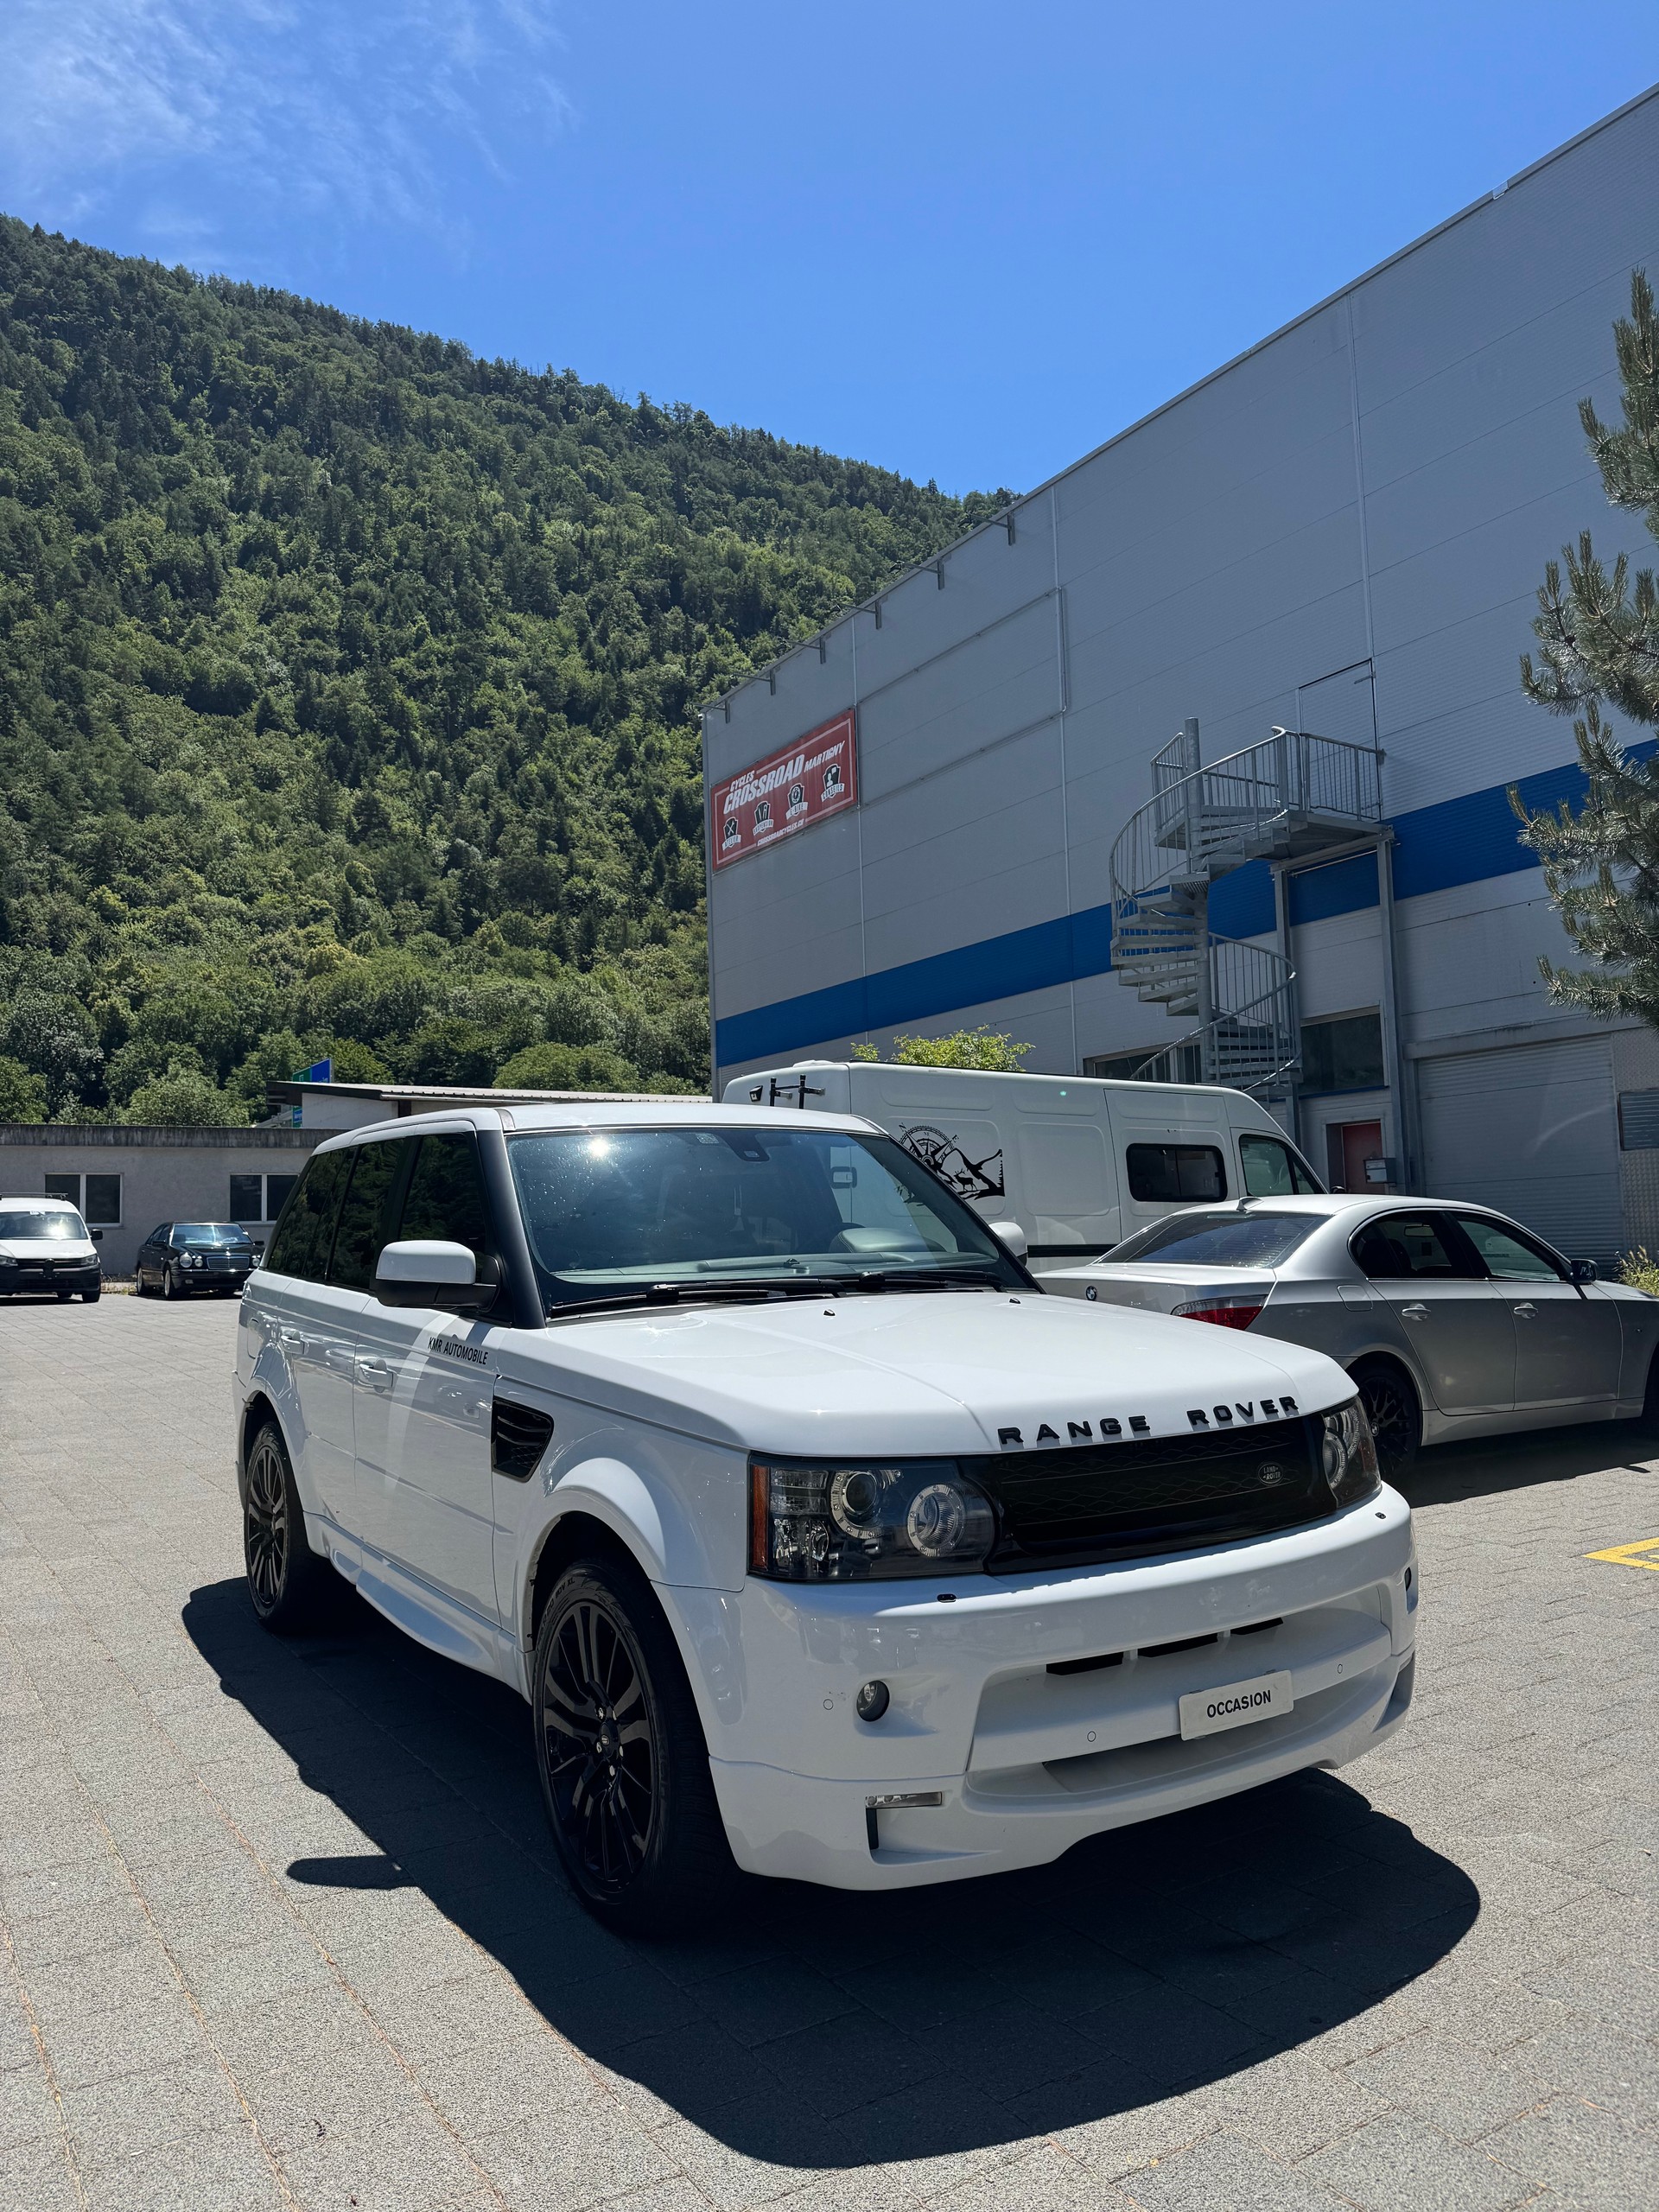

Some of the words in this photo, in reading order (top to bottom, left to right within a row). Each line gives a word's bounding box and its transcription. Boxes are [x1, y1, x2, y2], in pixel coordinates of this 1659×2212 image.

[723, 754, 804, 814] CROSSROAD
[804, 741, 845, 772] MARTIGNY
[729, 770, 754, 791] CYCLES
[428, 1337, 443, 1352] KMR
[443, 1342, 488, 1365] AUTOMOBILE
[997, 1414, 1151, 1445] RANGE
[1186, 1395, 1300, 1426] ROVER
[1206, 1689, 1272, 1719] OCCASION
